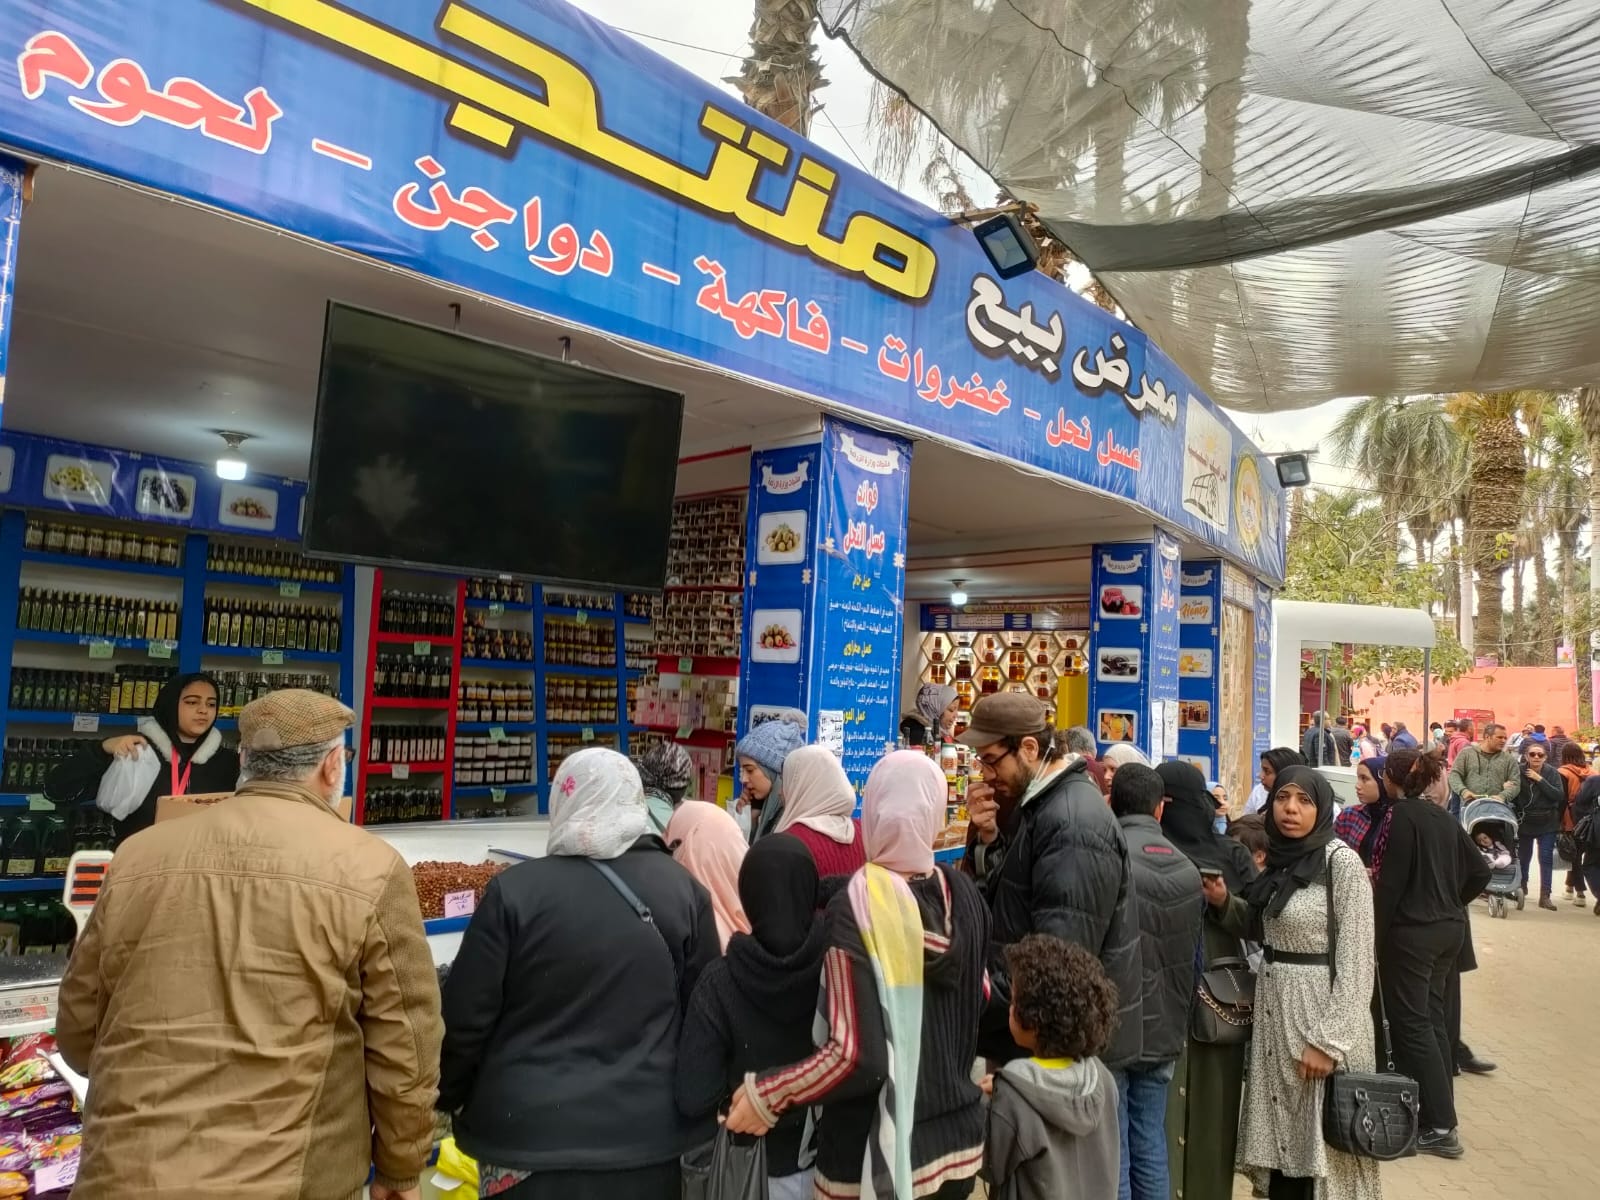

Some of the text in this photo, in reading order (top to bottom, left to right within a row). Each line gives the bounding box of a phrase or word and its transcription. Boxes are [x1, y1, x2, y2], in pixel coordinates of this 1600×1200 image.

[17, 31, 283, 155] لحوم
[238, 0, 1178, 423] معرض بيع منتج
[393, 155, 613, 277] دواجن
[695, 256, 831, 354] فاكهة
[877, 334, 1012, 417] خضروات
[1045, 408, 1093, 452] نحل
[1096, 430, 1142, 471] عسل
[843, 518, 886, 560] عسل النحل
[856, 479, 879, 516] فوائد
